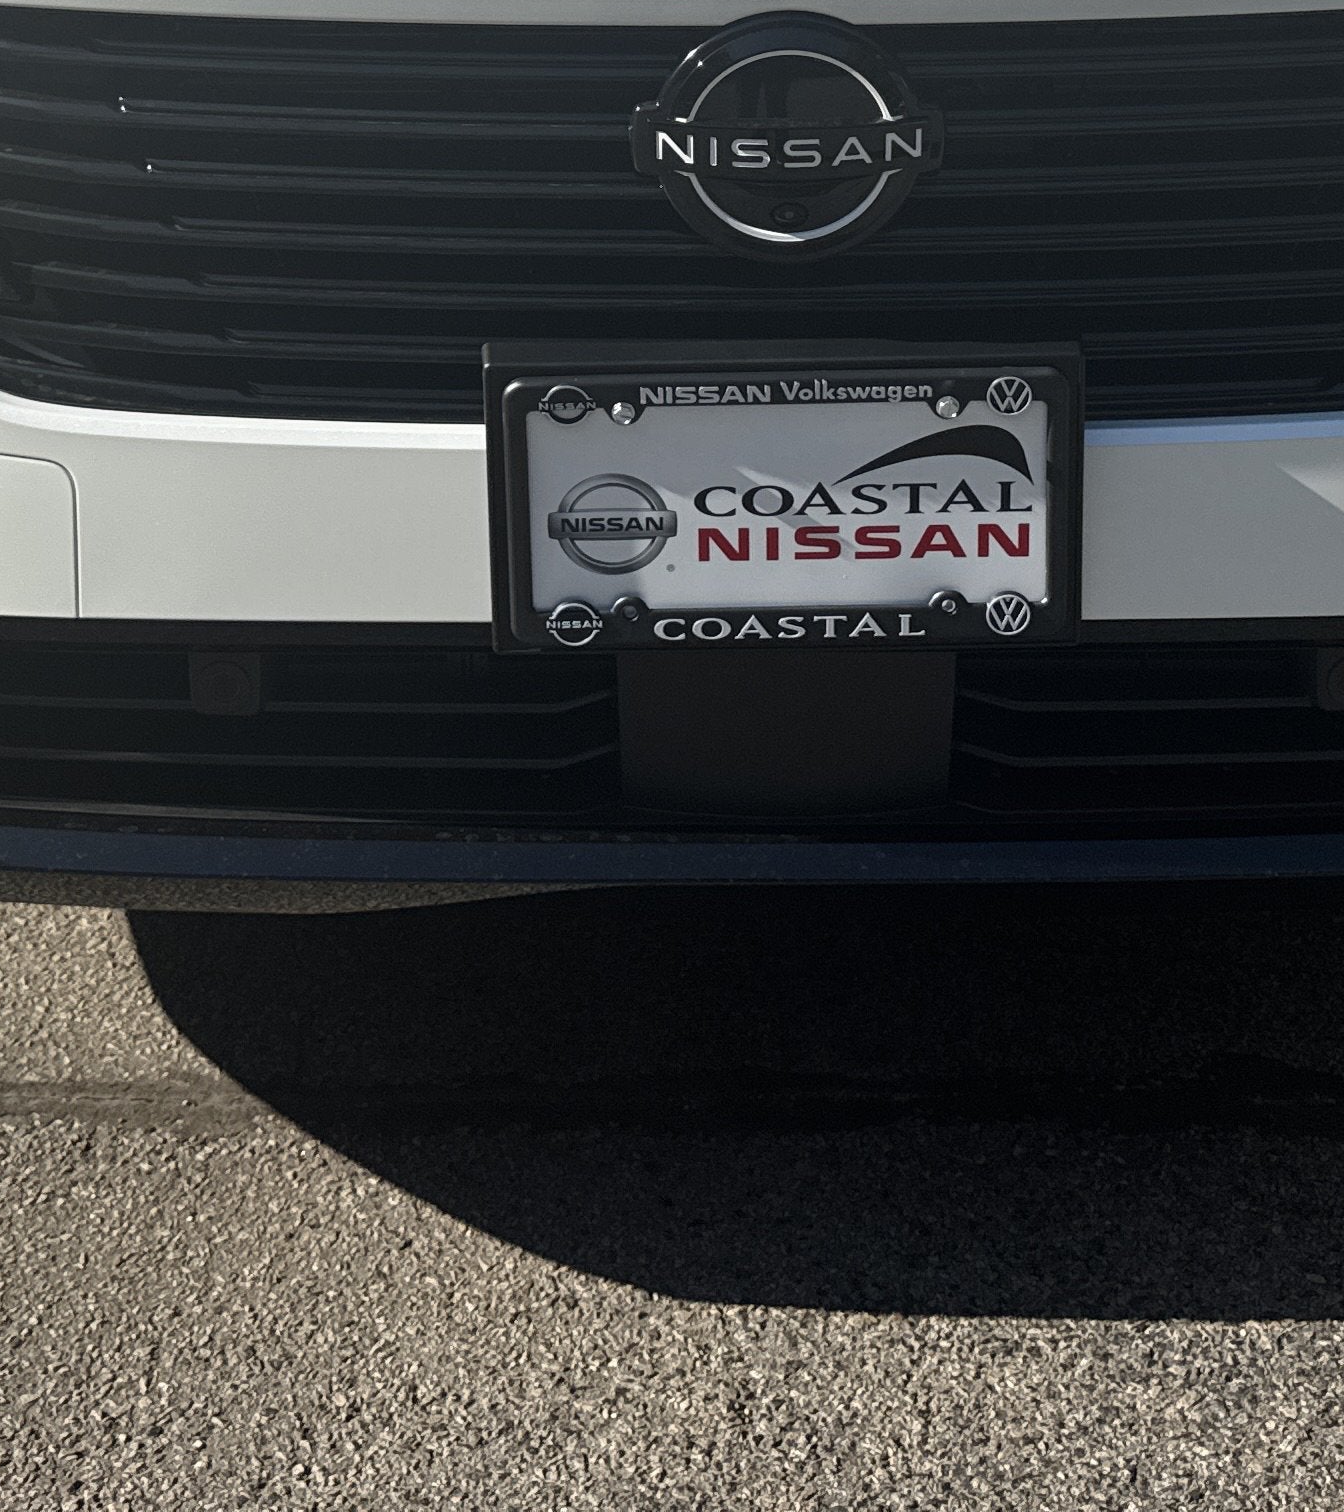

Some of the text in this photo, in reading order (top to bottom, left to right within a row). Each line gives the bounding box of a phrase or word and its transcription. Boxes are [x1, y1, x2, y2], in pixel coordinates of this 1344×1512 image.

[656, 128, 923, 169] NISSAN
[638, 379, 933, 405] NISSAN Volkswagen
[538, 400, 596, 412] NISSAN
[693, 481, 1033, 517] COASTAL
[561, 515, 664, 534] NISSAN
[697, 522, 1030, 563] NISSAN
[546, 619, 603, 631] NISSAN
[654, 613, 926, 641] COASTAL
